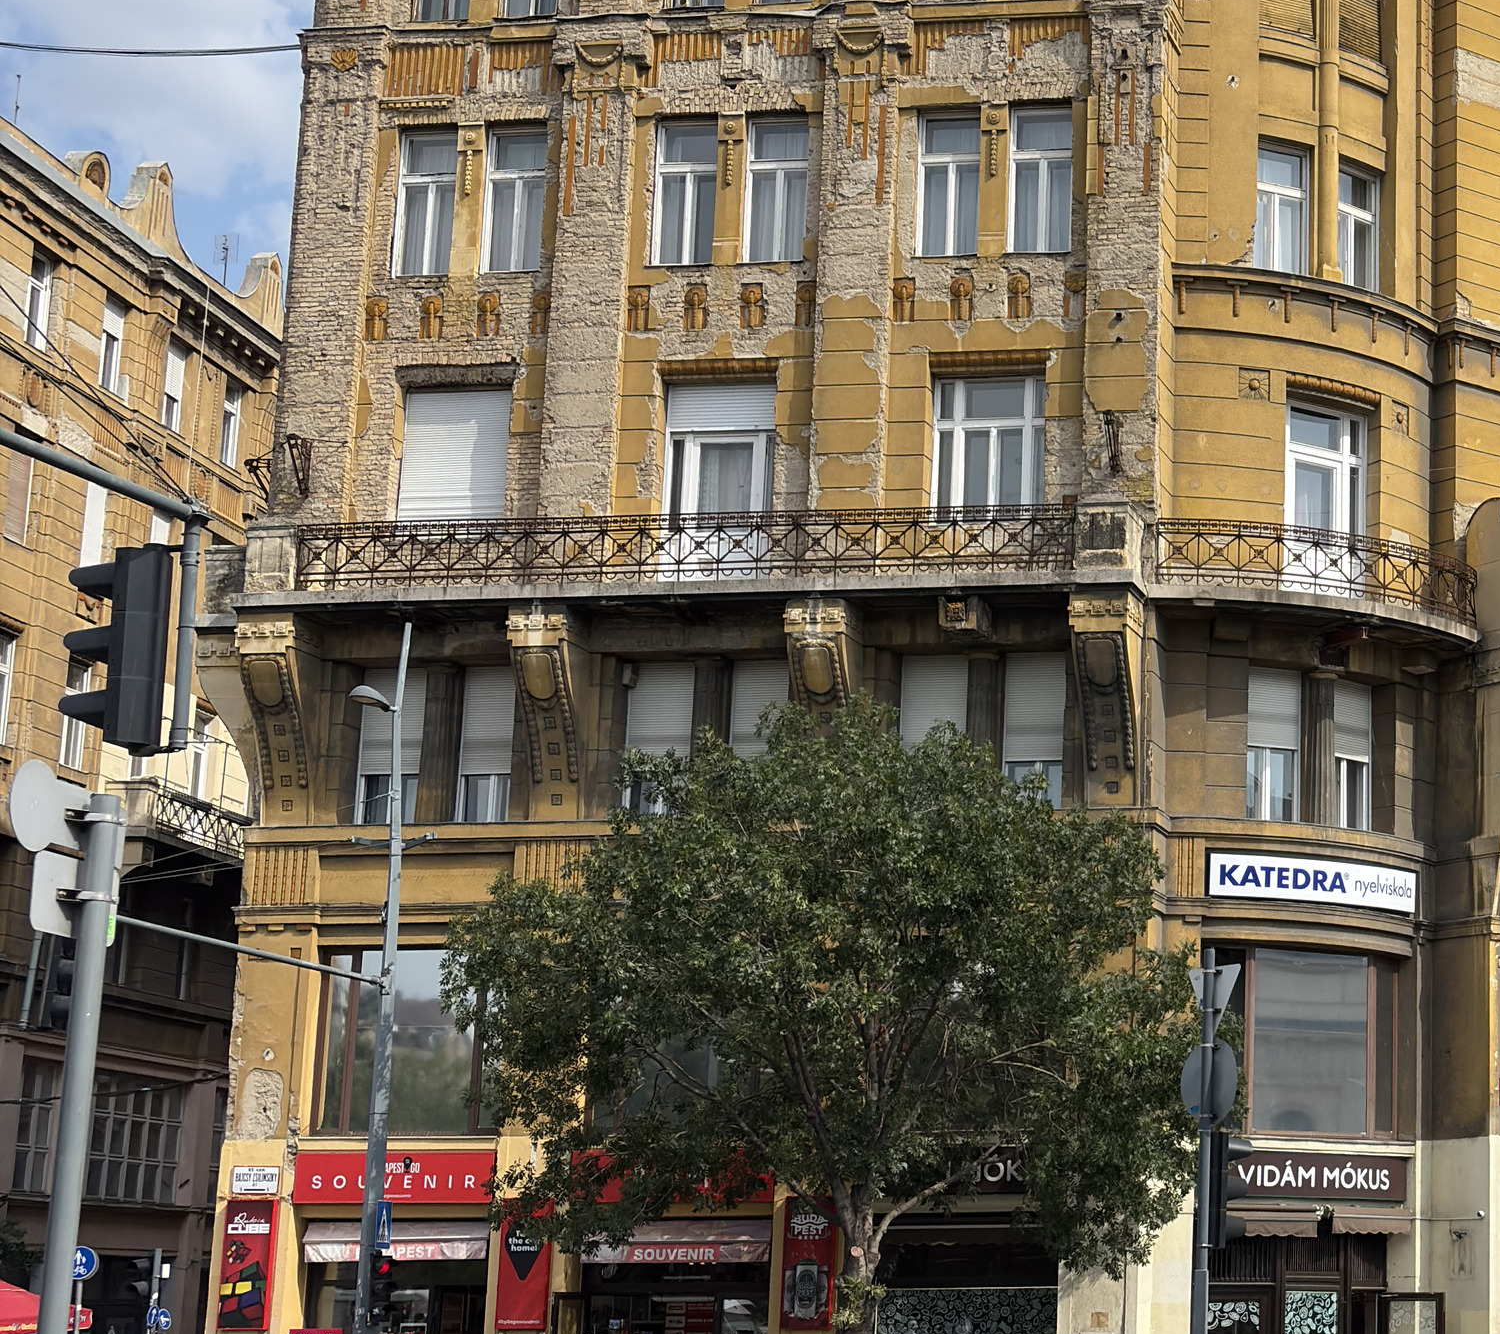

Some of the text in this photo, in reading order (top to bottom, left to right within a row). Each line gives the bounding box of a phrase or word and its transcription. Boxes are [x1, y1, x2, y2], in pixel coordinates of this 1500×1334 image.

[1354, 873, 1412, 899] nyelviskola
[1237, 1160, 1390, 1191] VIDÁM MÓKUS
[227, 1223, 270, 1234] CUBE
[793, 1225, 824, 1235] PEST
[633, 1248, 715, 1261] SOUVENIR
